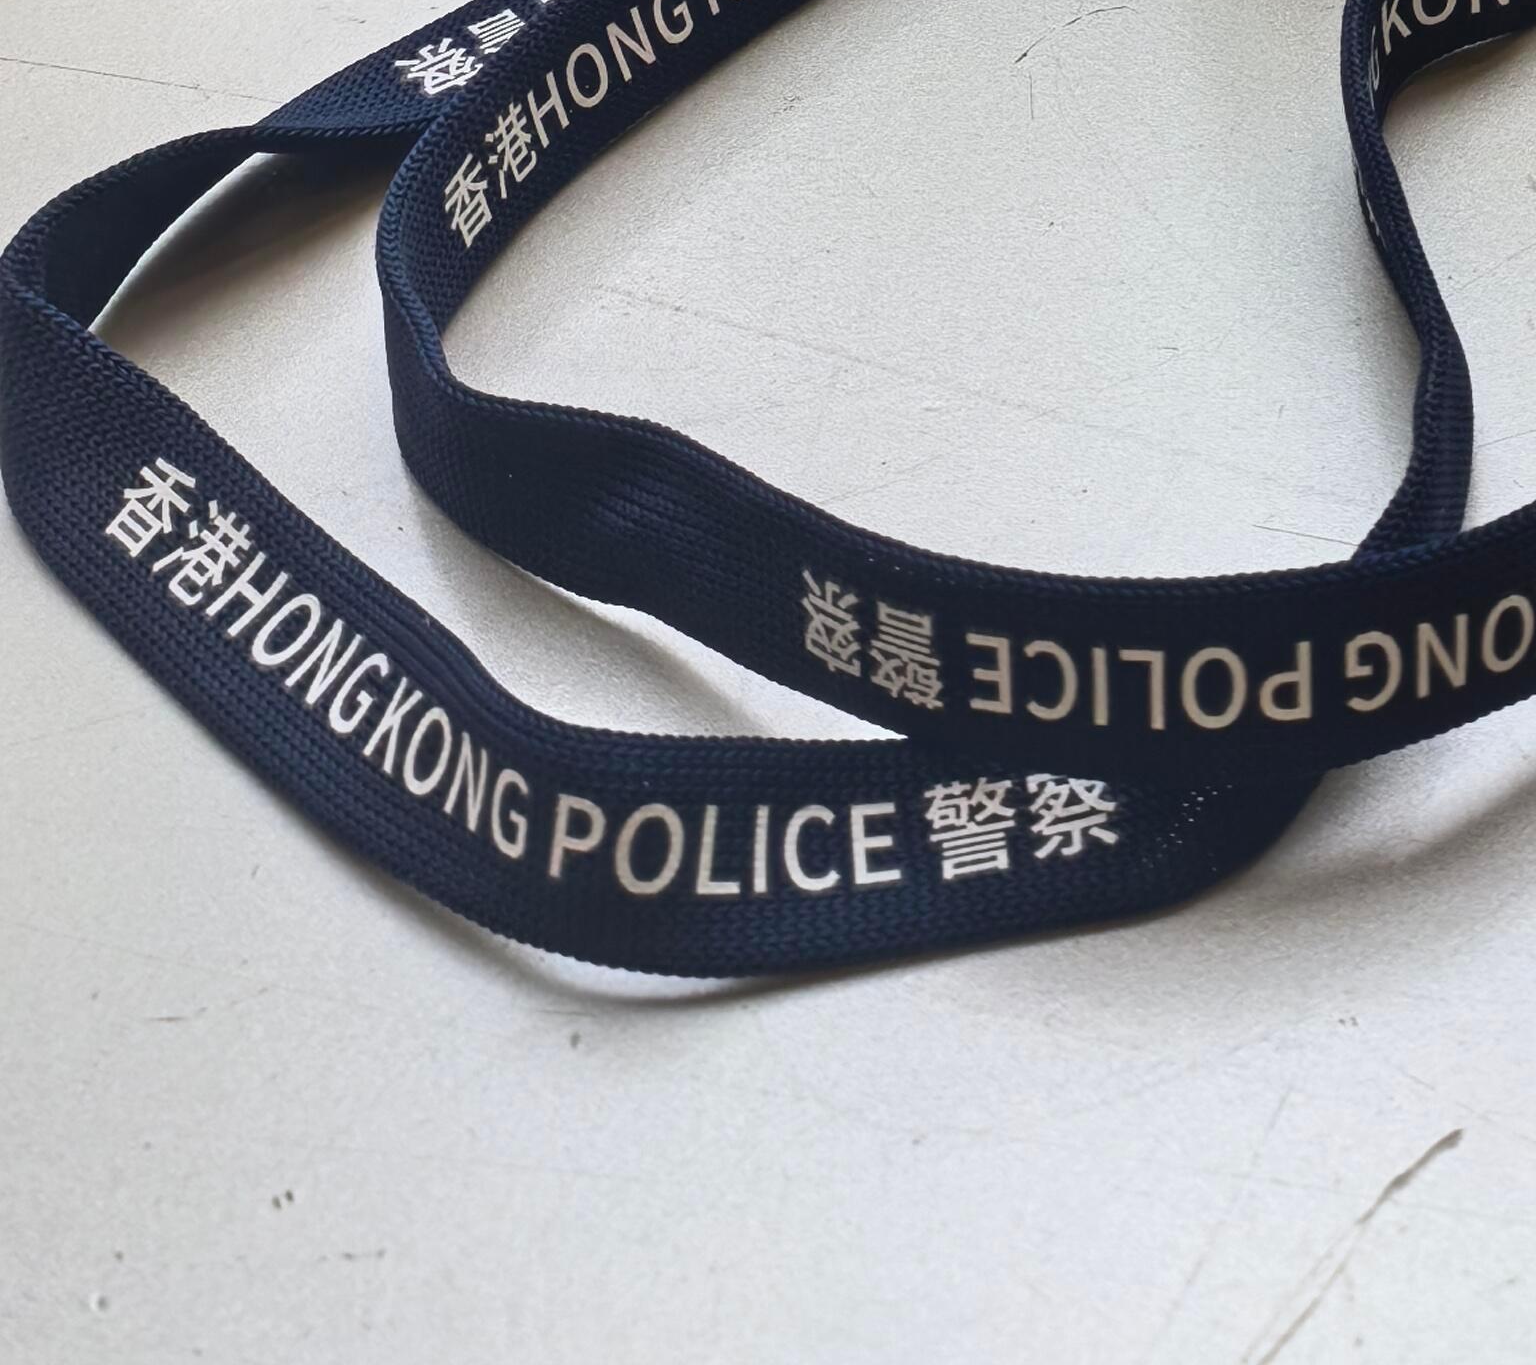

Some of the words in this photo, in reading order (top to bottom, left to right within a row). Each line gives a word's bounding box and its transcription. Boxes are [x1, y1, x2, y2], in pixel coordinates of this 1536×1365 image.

[801, 569, 944, 709] 警察
[966, 632, 1314, 730] POLICE
[549, 793, 903, 895] POLICE
[924, 773, 1119, 881] 警察
